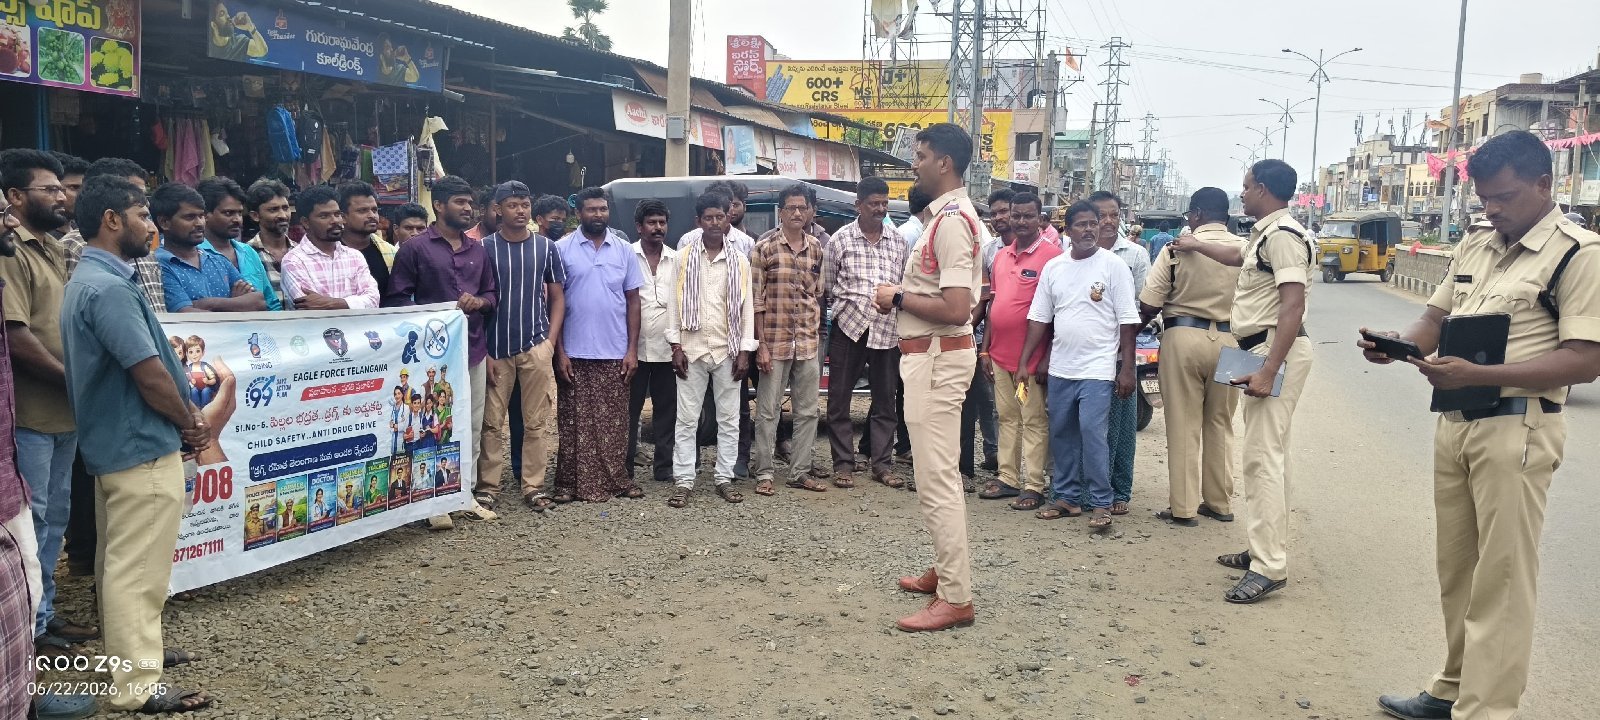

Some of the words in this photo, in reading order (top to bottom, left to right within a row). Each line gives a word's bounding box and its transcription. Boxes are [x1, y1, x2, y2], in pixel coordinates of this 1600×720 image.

[306, 29, 374, 57] గురురాఘవేంద్ర
[806, 77, 843, 89] 600+
[854, 87, 871, 96] MS
[811, 91, 839, 102] CRS
[626, 104, 647, 119] Aachi
[293, 371, 318, 382] EAGLE
[320, 368, 345, 378] FORCE
[347, 363, 388, 376] TELANGANA
[249, 386, 273, 408] 99
[270, 416, 293, 431] పిల్లల
[342, 405, 352, 416] కు
[354, 401, 383, 417] అడ్డుకట్ట
[247, 439, 273, 450] CHILD
[332, 425, 353, 434] DRUG
[355, 420, 377, 431] DRIVE
[268, 462, 288, 473] రహిత
[289, 456, 318, 468] తెలంగాణ
[319, 452, 333, 462] మన
[368, 463, 388, 472] TEACHER
[281, 482, 304, 491] FARMER
[311, 475, 335, 485] DOCTOR
[173, 537, 224, 563] 8712671111
